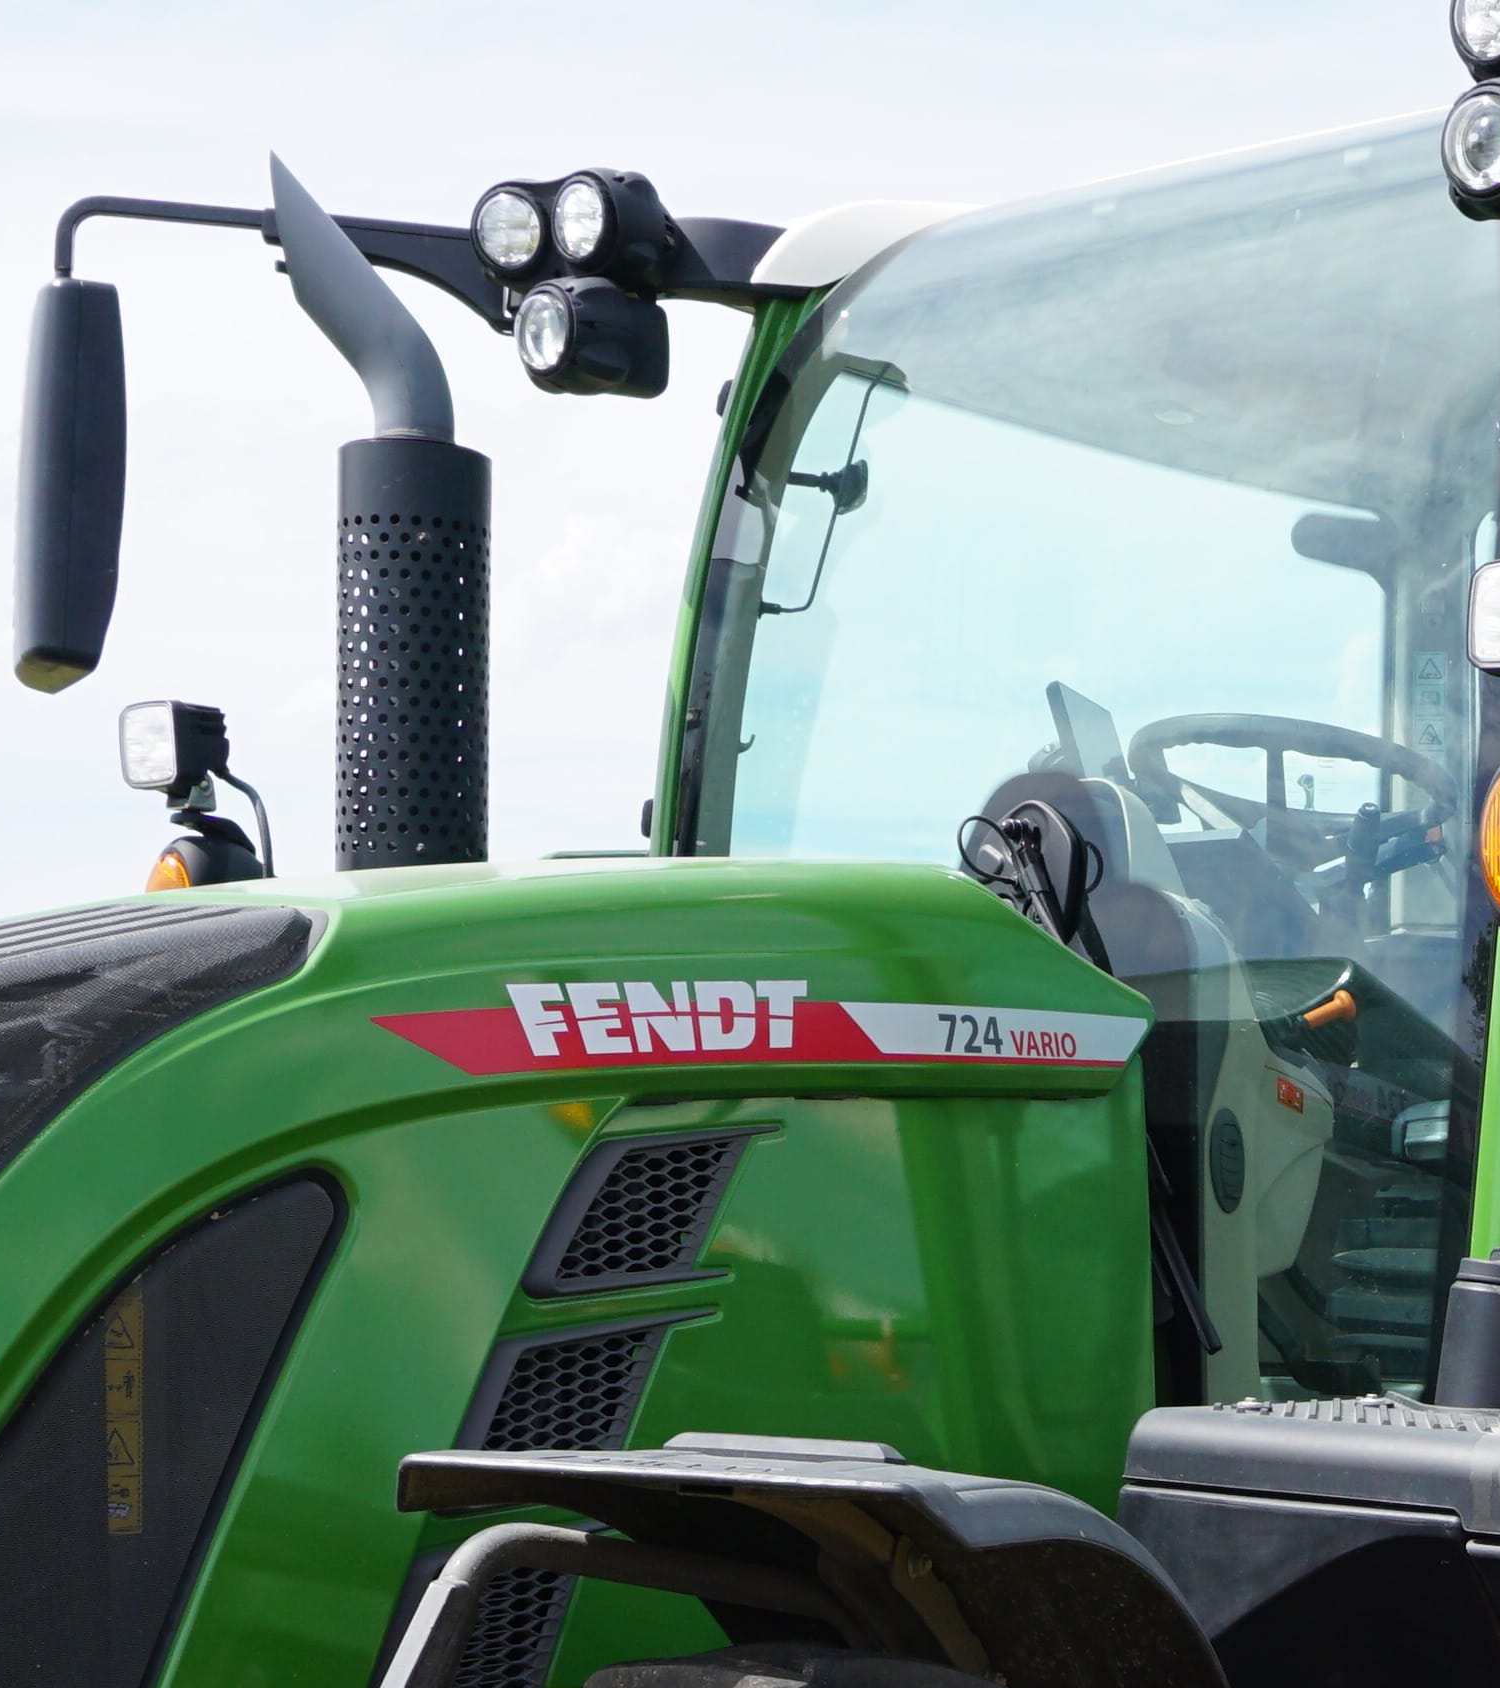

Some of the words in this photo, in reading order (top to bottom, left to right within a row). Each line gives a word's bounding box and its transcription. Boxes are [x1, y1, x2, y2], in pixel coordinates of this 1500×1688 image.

[505, 979, 808, 1057] FENDT
[938, 1013, 1003, 1056] 724
[1009, 1030, 1078, 1059] VARIO
